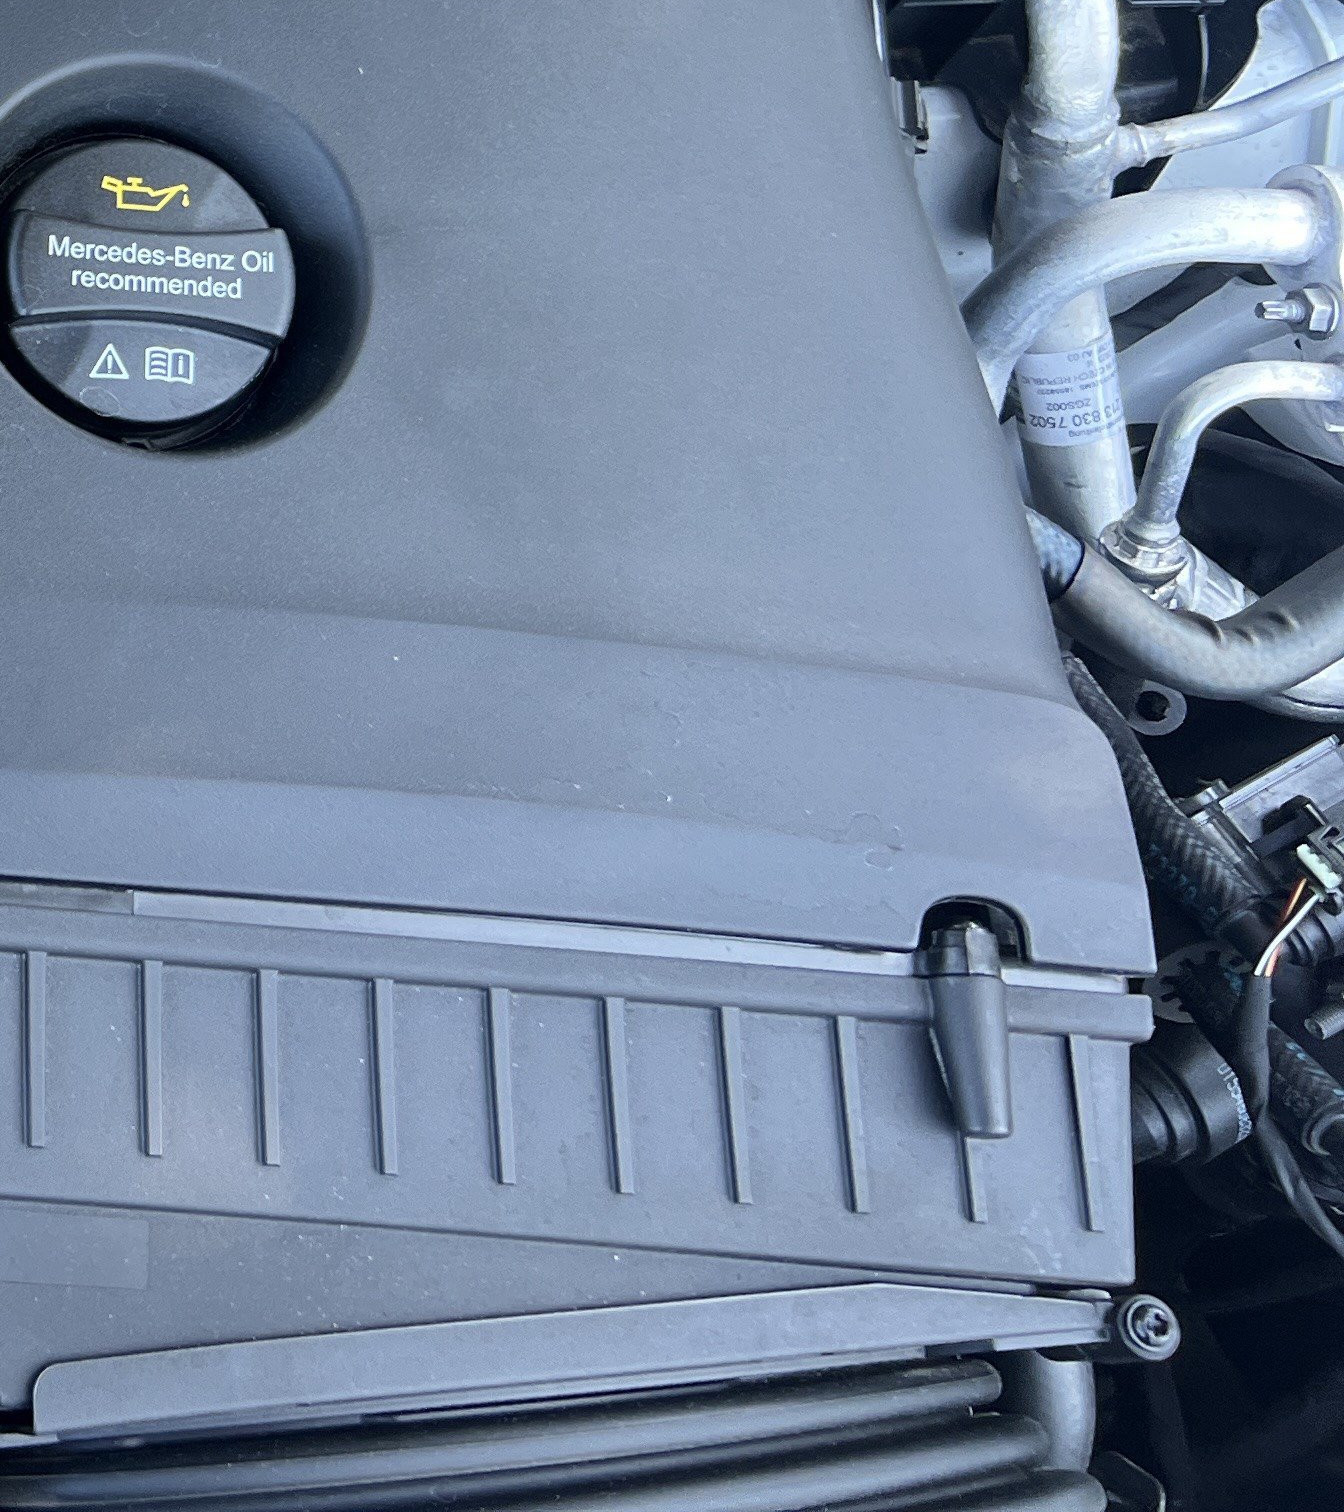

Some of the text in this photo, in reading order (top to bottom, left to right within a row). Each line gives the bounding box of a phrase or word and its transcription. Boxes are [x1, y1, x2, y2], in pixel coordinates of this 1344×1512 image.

[48, 234, 275, 273] Mercedes-Benz Oil
[71, 269, 243, 300] recommended
[1072, 410, 1101, 427] 830
